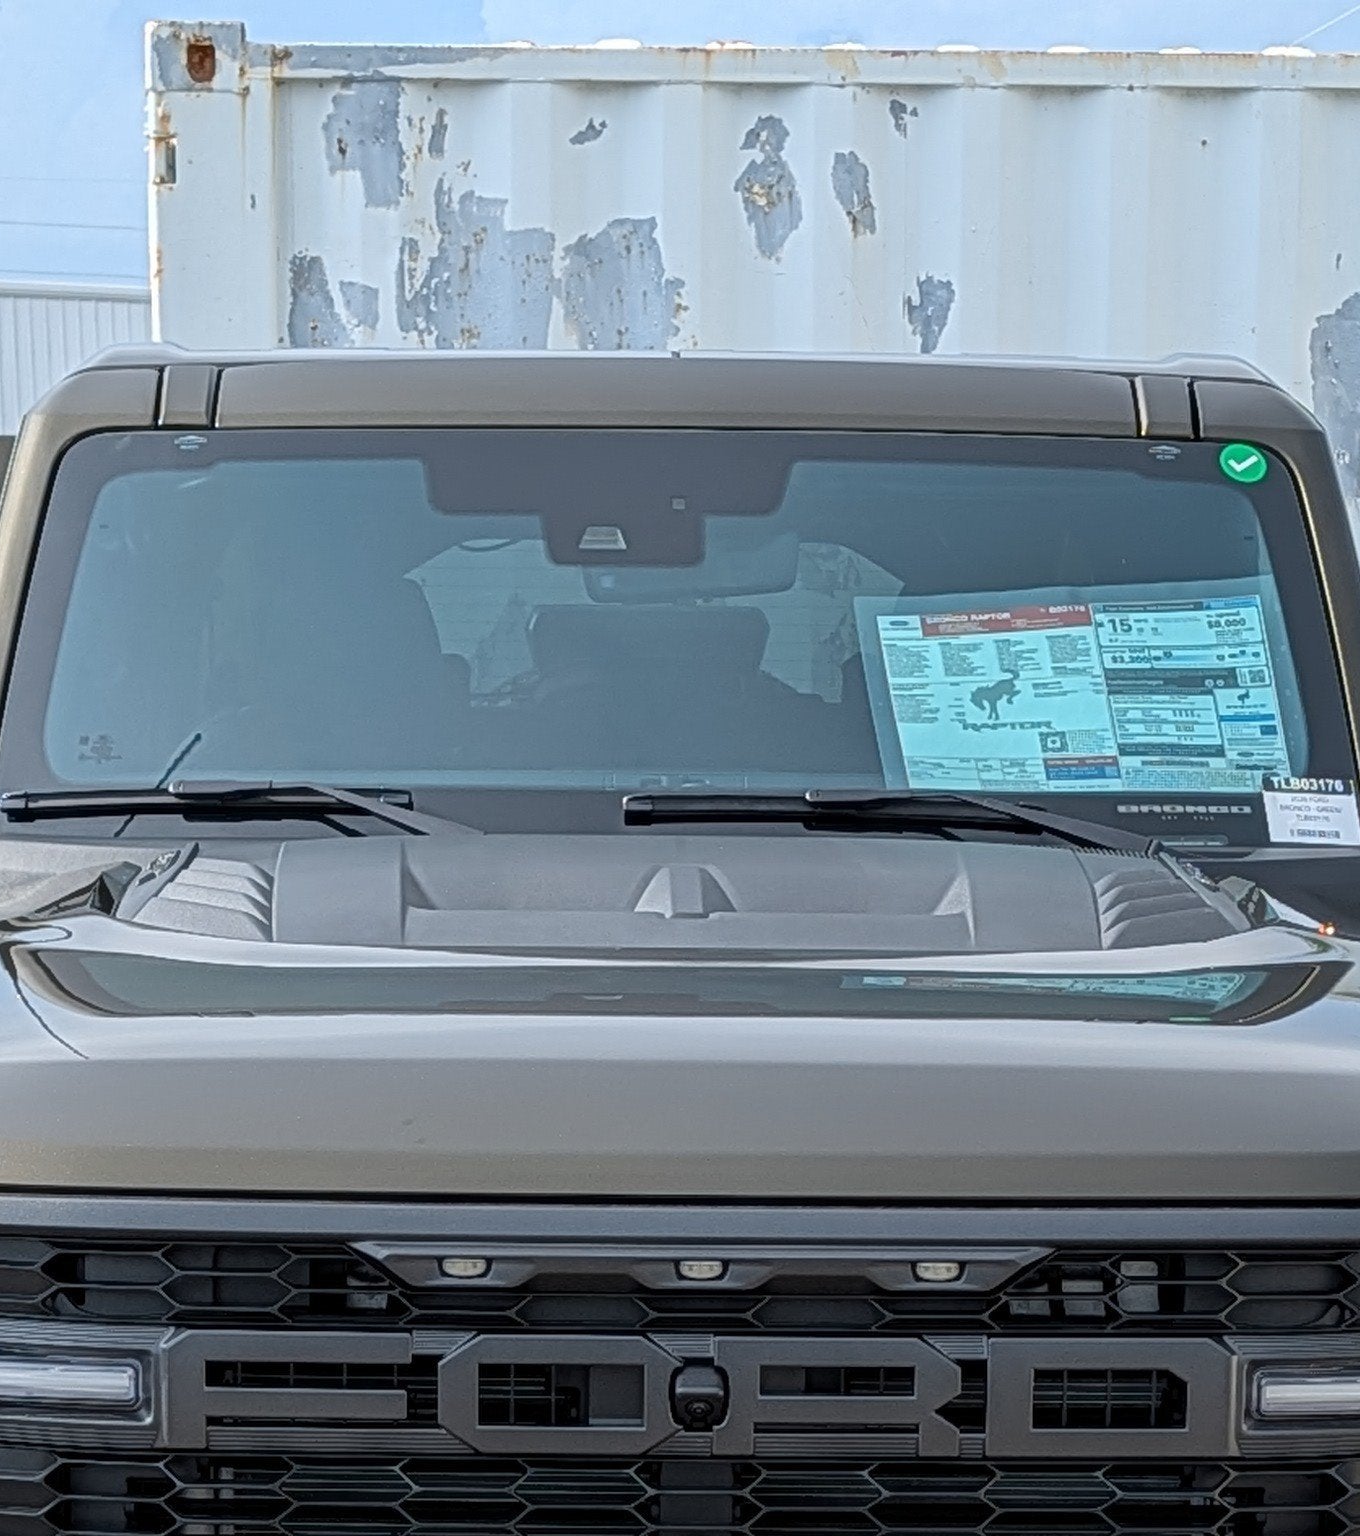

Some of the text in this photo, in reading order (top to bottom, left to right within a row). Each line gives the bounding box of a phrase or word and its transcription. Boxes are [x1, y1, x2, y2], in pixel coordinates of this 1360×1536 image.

[1107, 618, 1133, 633] 15
[1269, 776, 1345, 793] TLB03176
[1117, 804, 1252, 814] BRONCO
[157, 1331, 1237, 1457] FORD
